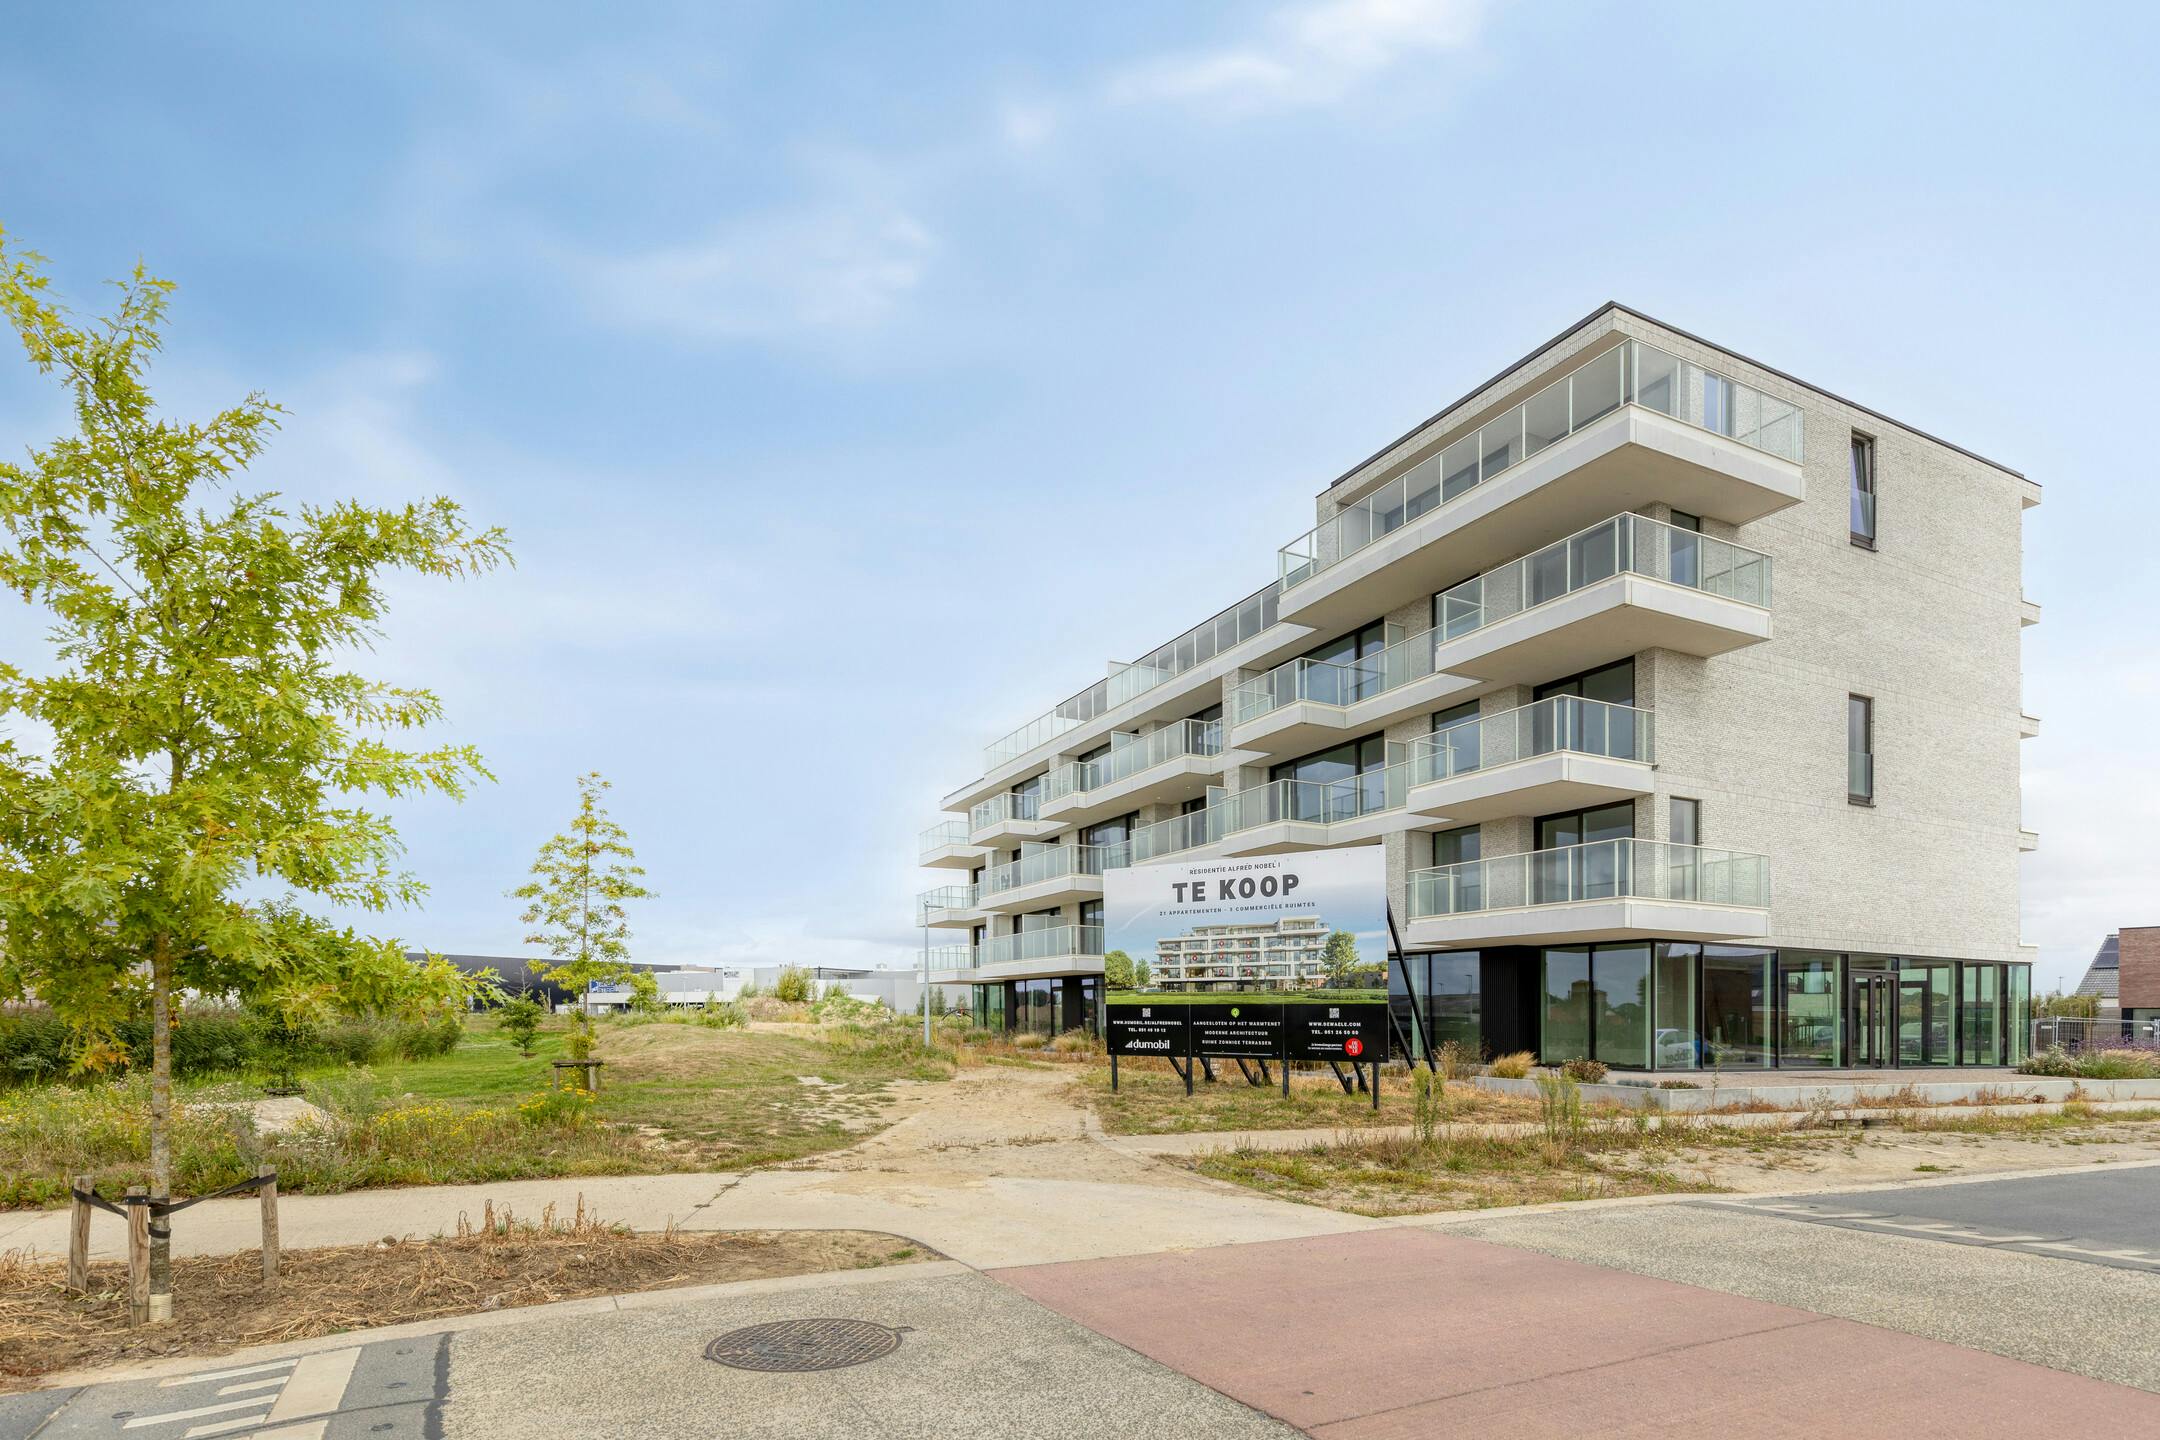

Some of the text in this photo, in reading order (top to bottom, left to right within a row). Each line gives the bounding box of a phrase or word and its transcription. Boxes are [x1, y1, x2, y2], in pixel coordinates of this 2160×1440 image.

[1189, 865, 1227, 875] RESIDENTIE
[1228, 864, 1252, 872] ALFRED
[1254, 862, 1276, 870] NOBEL
[1172, 874, 1299, 903] TE KOOP
[1168, 908, 1222, 916] APPARTEMENTEN
[1235, 903, 1283, 912] COMMERCIËLE
[1133, 1039, 1170, 1049] dumobil
